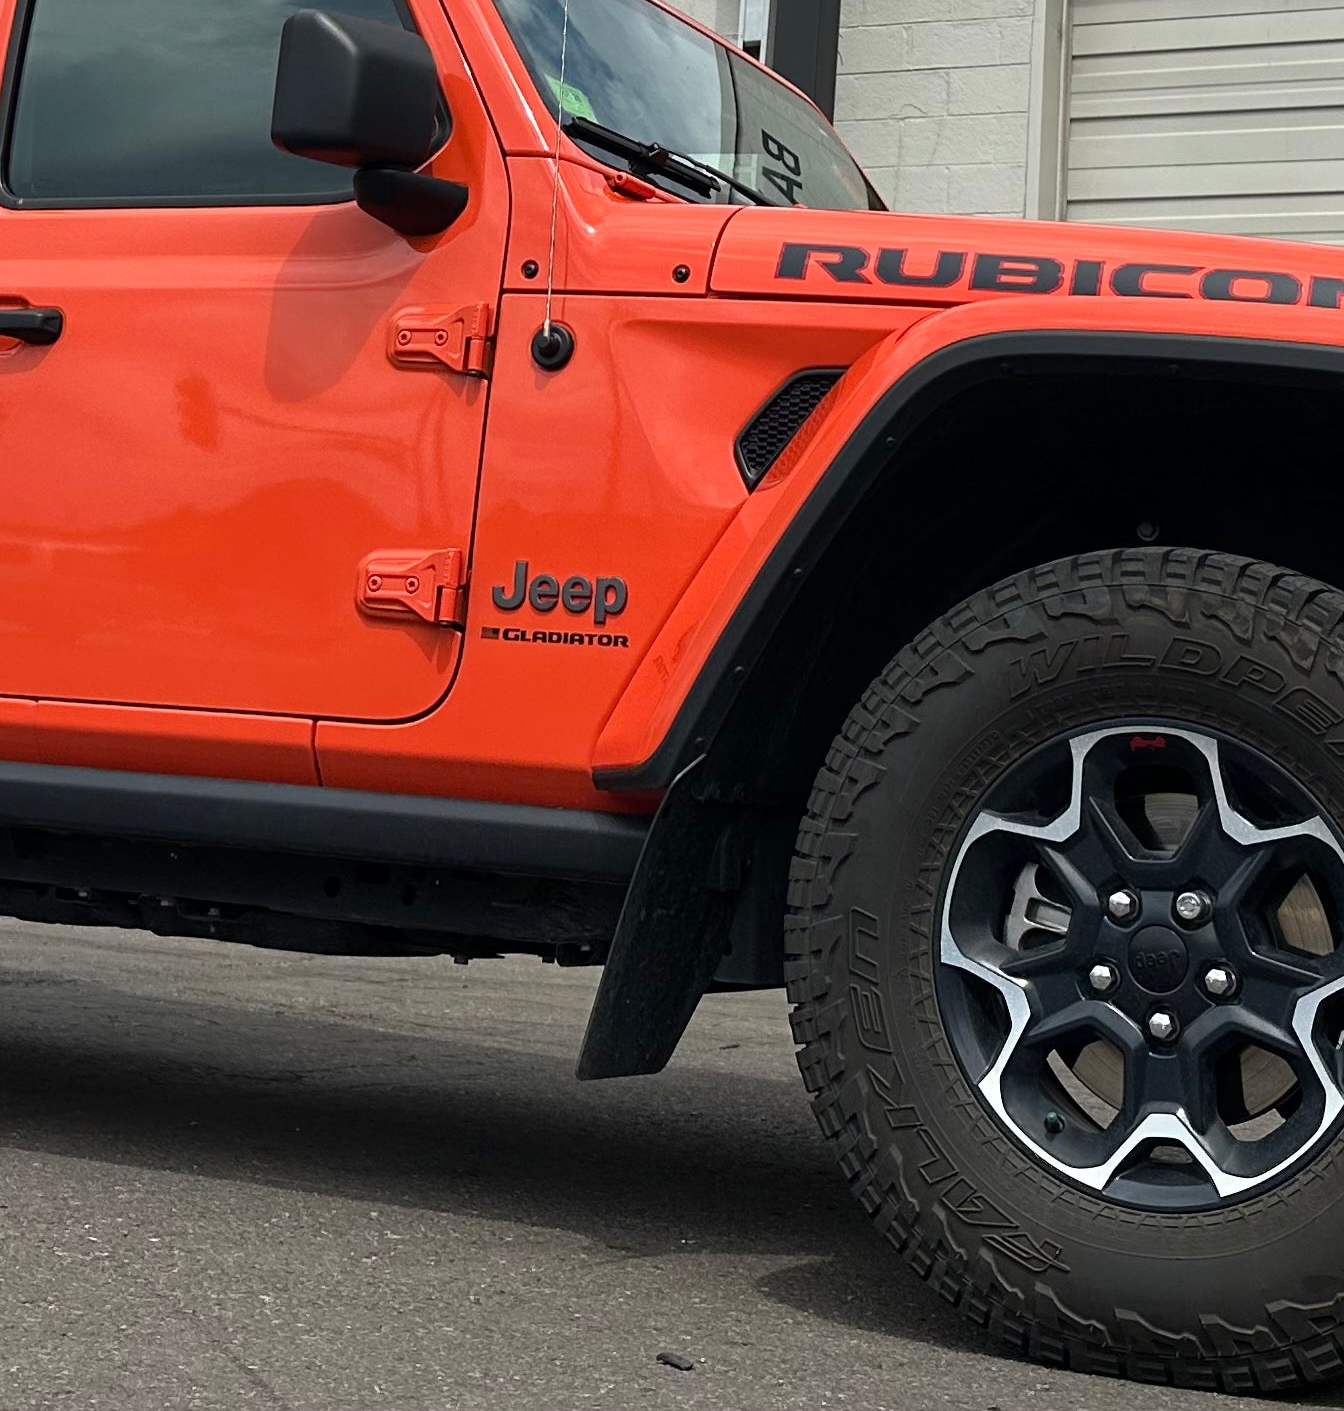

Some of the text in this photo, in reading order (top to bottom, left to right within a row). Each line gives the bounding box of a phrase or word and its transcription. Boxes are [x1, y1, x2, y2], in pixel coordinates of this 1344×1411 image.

[491, 560, 630, 626] Jeep
[501, 627, 630, 649] GLADIATOR
[848, 906, 1071, 1273] FALKEN
